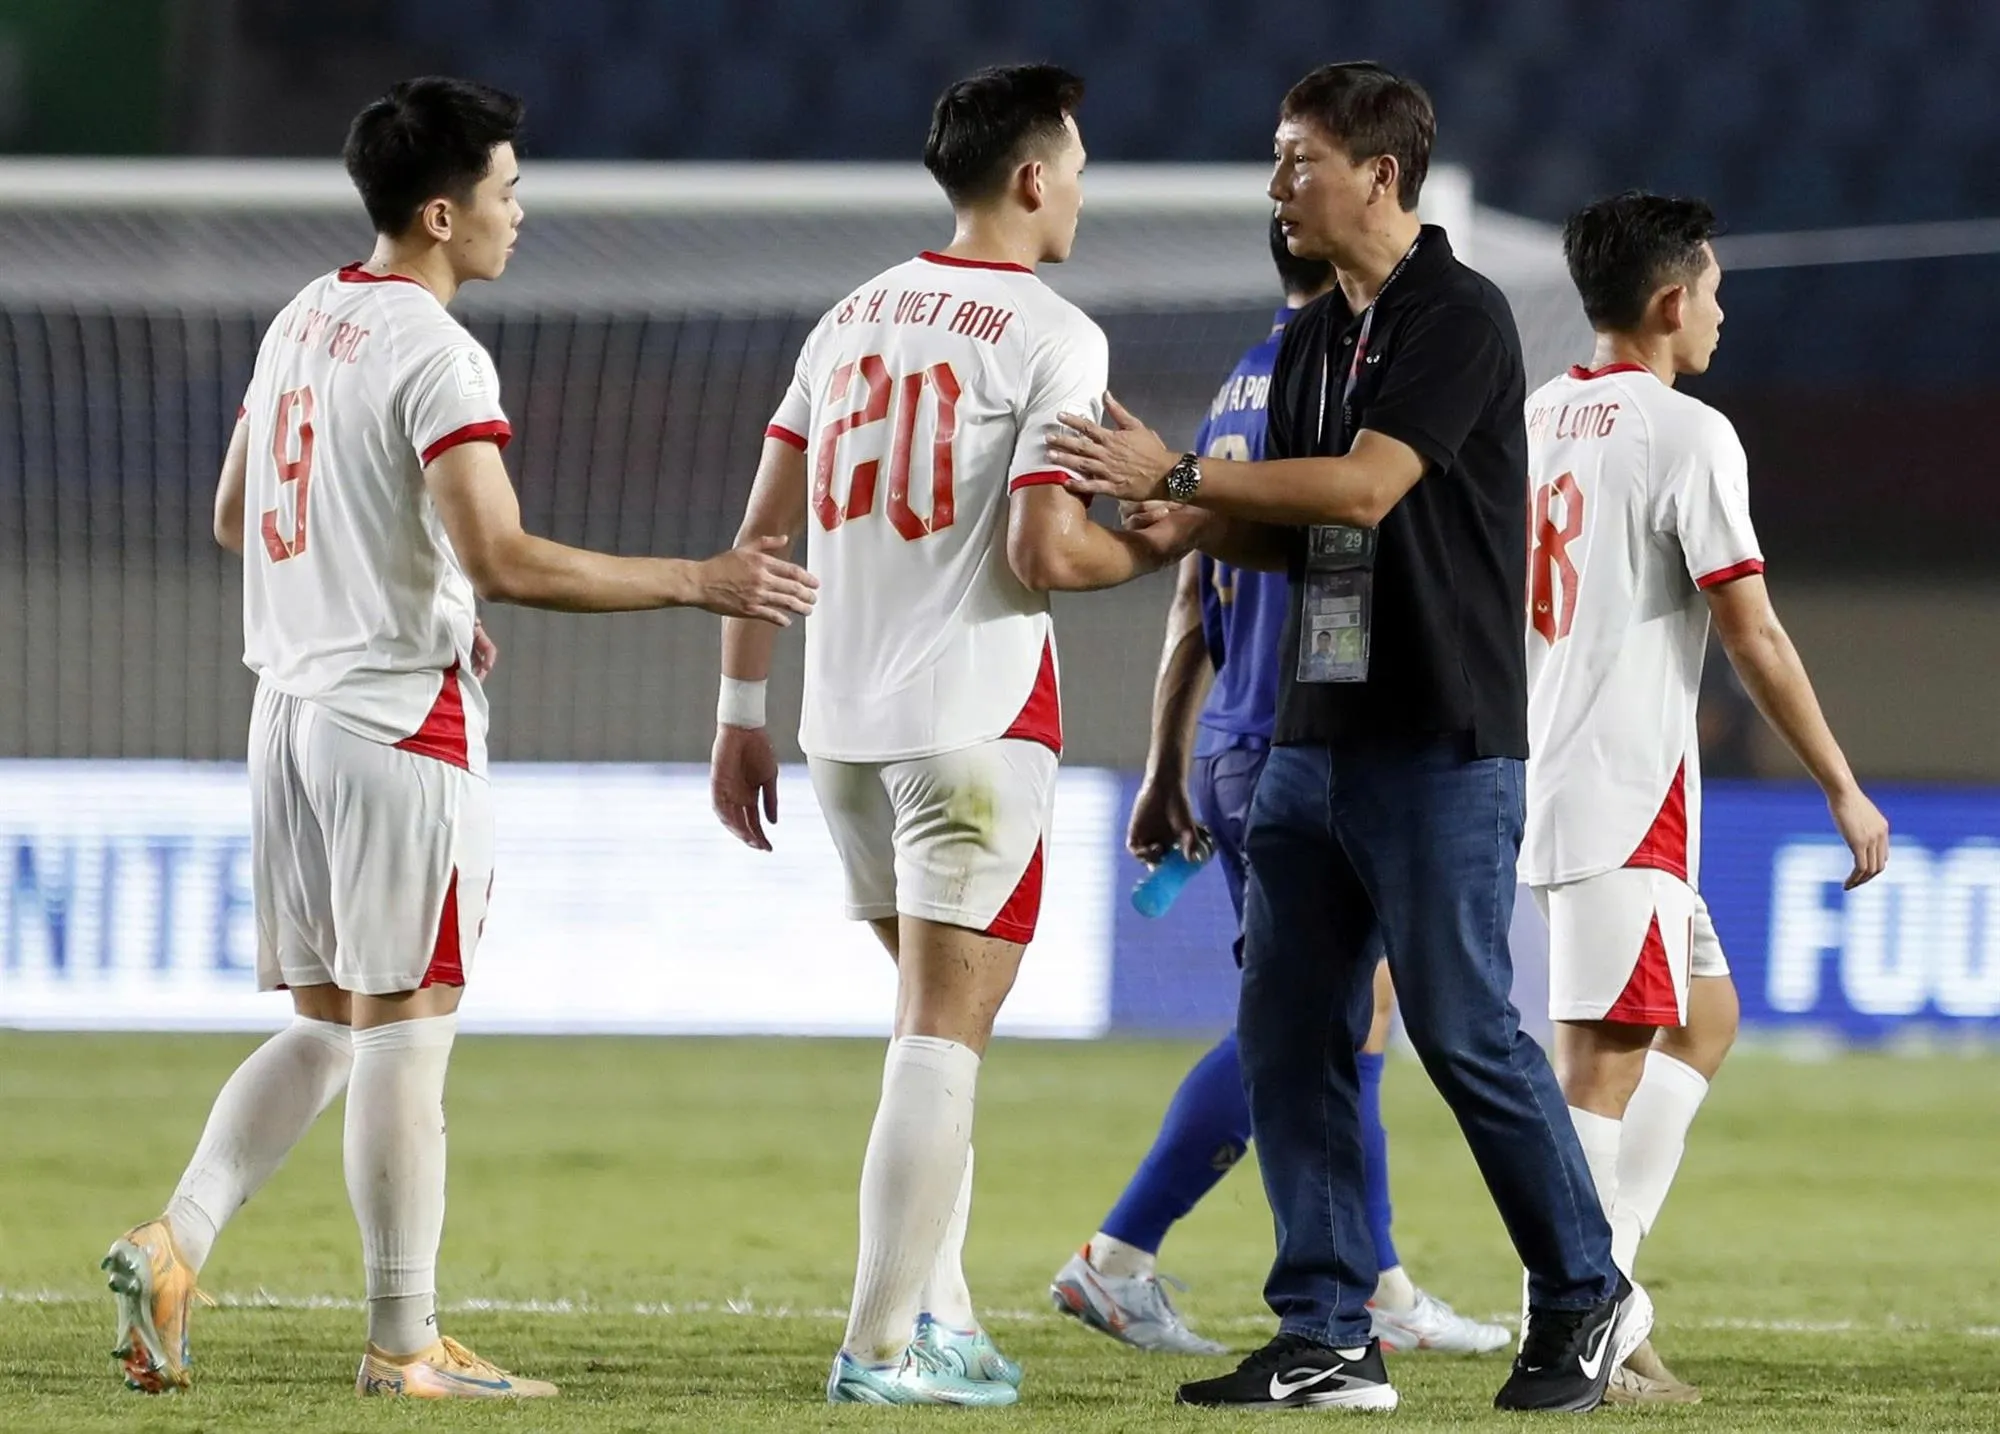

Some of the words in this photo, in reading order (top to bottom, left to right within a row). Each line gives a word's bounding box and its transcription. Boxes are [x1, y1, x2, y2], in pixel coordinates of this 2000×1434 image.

[861, 289, 888, 324] H.
[893, 290, 952, 326] VIET
[947, 300, 1013, 344] ANH
[261, 385, 315, 563] 9
[812, 354, 962, 541] 20
[1556, 403, 1619, 440] LONG
[1344, 532, 1362, 548] 29
[1526, 471, 1584, 647] 8
